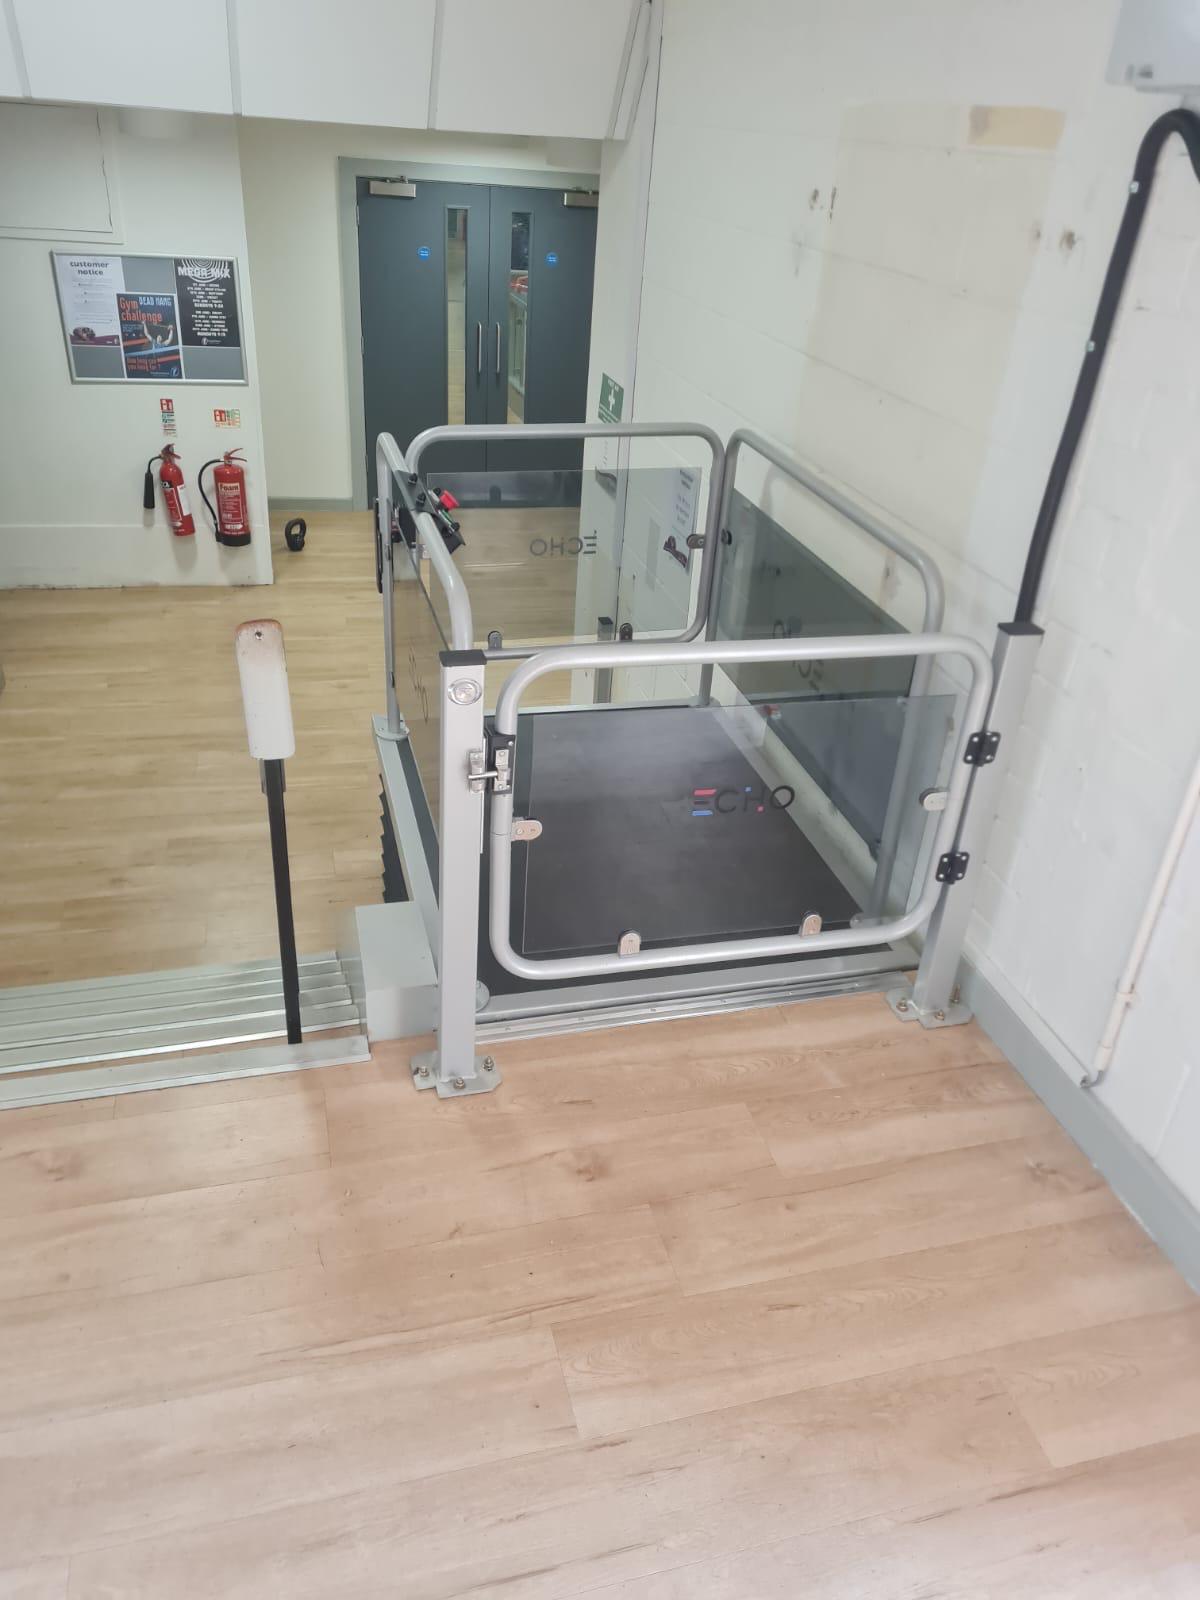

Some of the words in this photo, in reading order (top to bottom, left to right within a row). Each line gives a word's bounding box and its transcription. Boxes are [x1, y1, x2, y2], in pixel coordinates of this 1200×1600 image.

[120, 297, 139, 311] Gym
[139, 296, 155, 306] DEAD
[121, 310, 162, 325] challenge
[691, 785, 796, 817] ECHO
